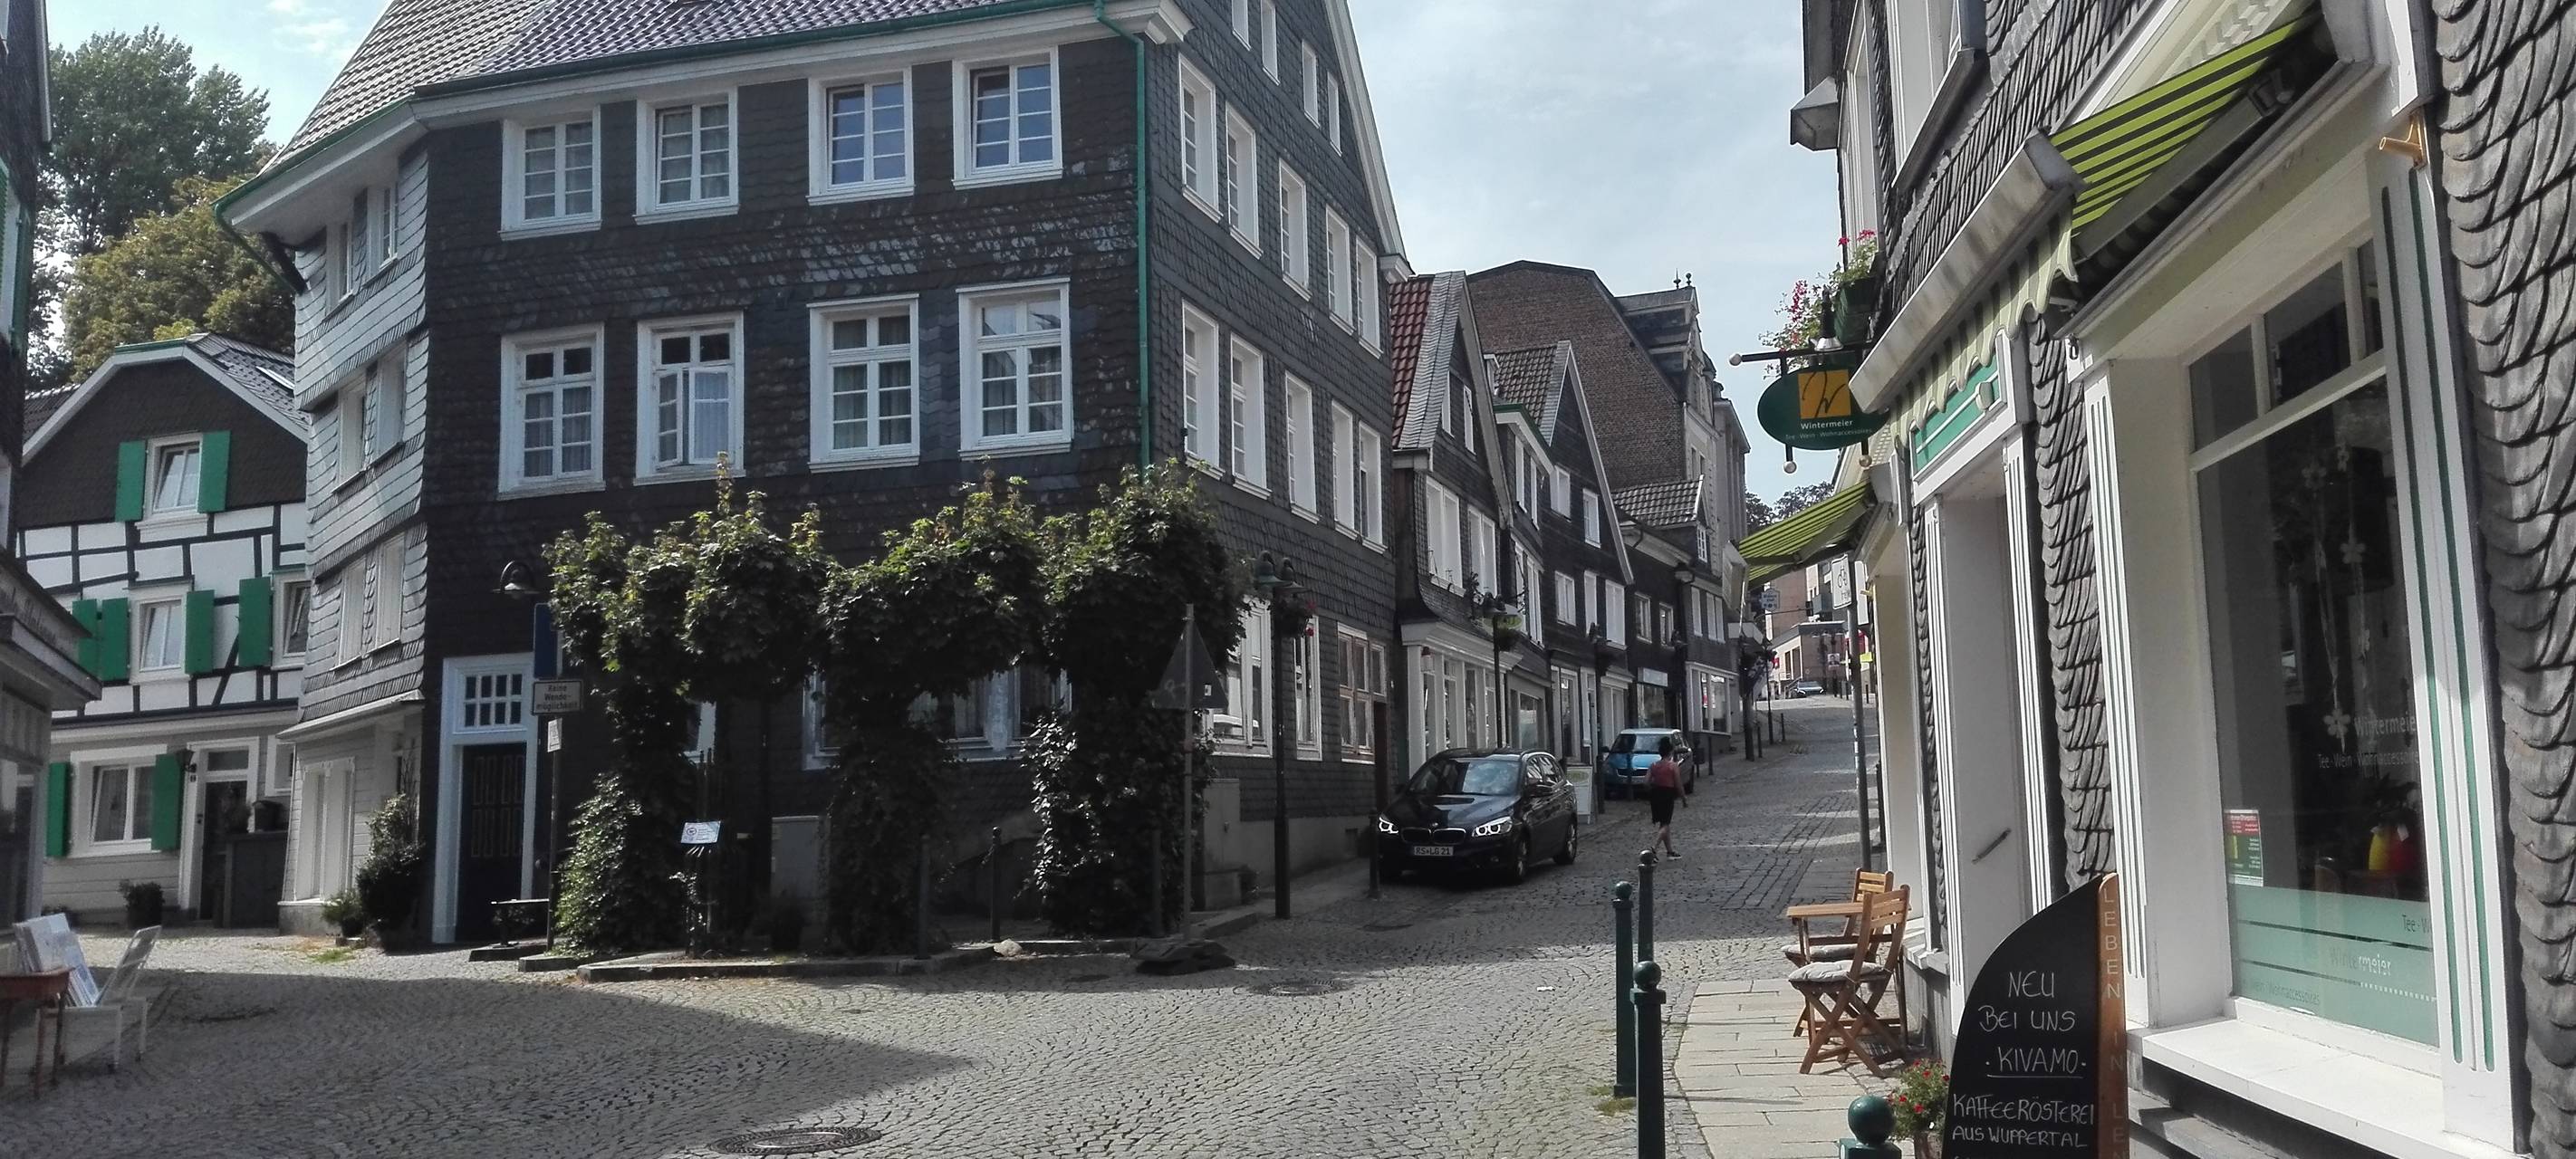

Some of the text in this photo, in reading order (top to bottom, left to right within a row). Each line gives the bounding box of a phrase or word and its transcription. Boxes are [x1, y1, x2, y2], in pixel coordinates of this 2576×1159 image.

[1801, 420, 1853, 429] Wintermeier
[2354, 711, 2417, 737] Wintermeie
[2358, 750, 2419, 768] Wohnaccessoire
[2402, 915, 2416, 933] Tee
[2102, 888, 2121, 999] LEBEN
[2008, 971, 2055, 998] NEU
[1978, 1005, 2076, 1032] BEI UNS
[1997, 1046, 2078, 1075] KIVAMO
[1953, 1094, 2095, 1125] KAFFEERÖSTEREI
[1952, 1126, 2088, 1148] AUS WUPPERTAL
